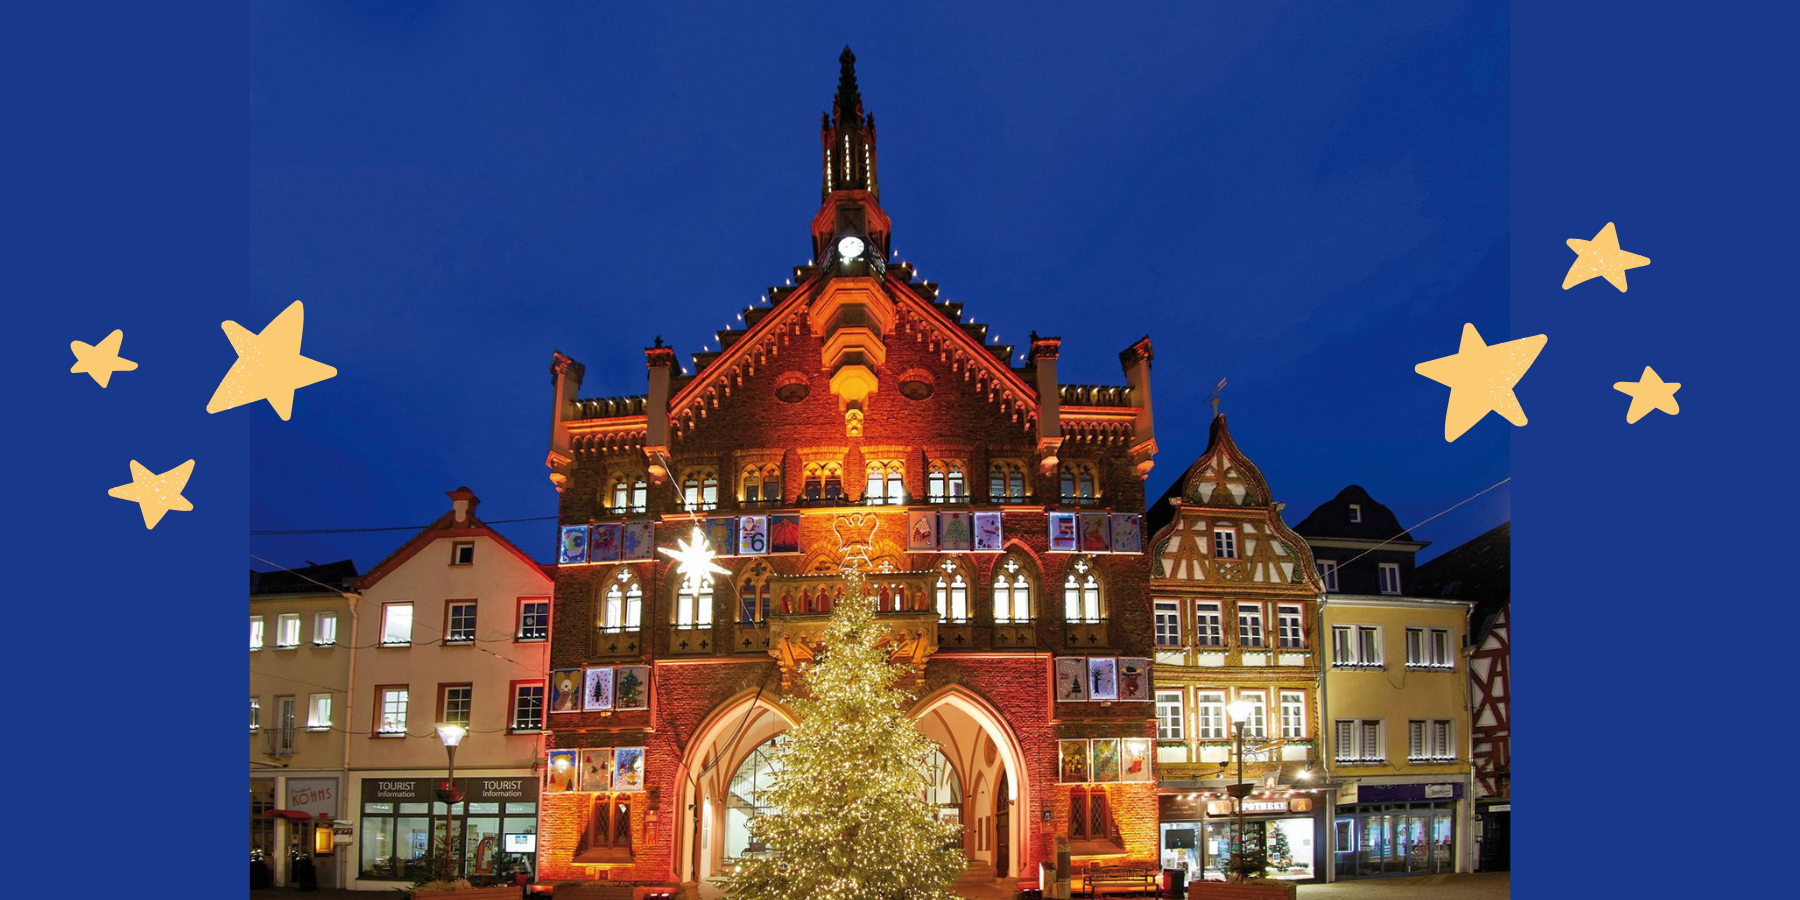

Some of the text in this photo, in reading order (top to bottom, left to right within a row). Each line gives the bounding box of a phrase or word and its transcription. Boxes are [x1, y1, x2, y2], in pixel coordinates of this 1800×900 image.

[1060, 523, 1073, 538] 5
[751, 532, 765, 552] 6
[378, 781, 416, 791] TOURIST
[483, 781, 523, 790] TOURIST
[377, 790, 415, 798] Information
